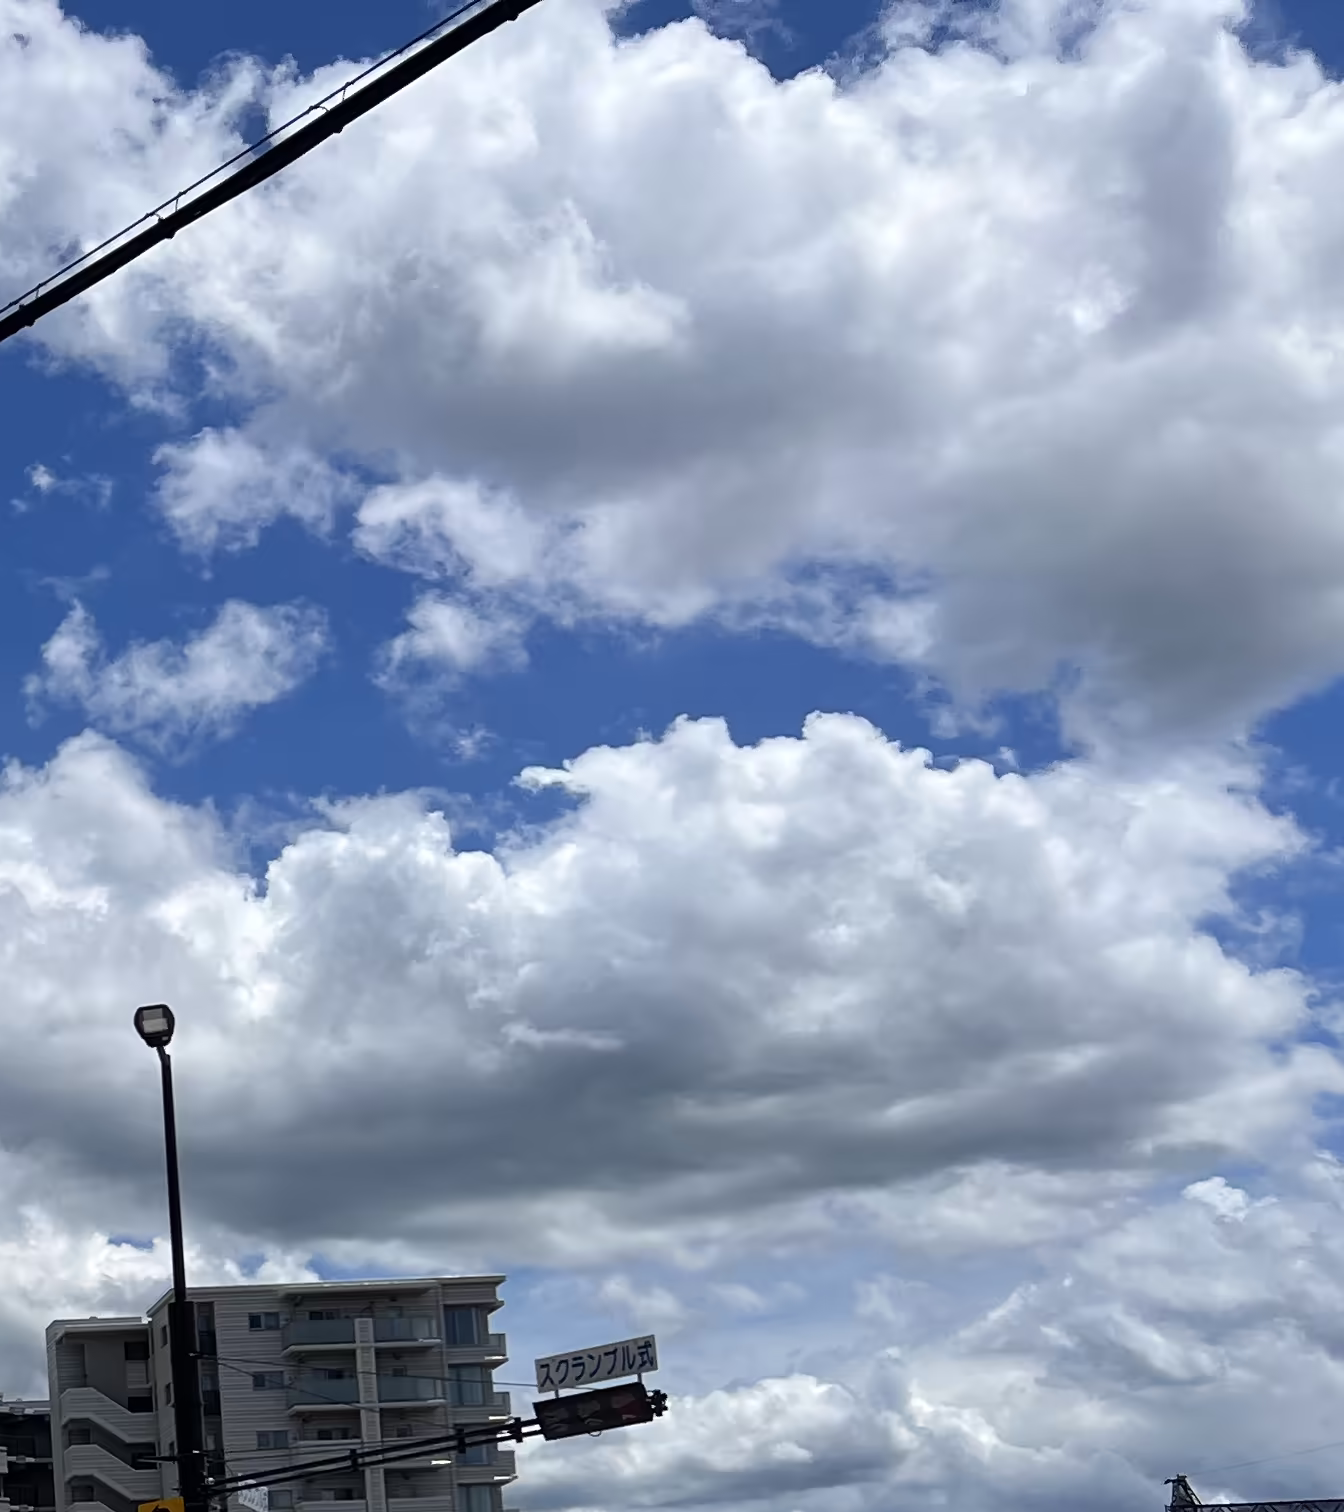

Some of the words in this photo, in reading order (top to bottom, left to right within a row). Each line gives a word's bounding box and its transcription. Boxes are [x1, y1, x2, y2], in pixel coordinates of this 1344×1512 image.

[540, 1341, 654, 1387] スクランブル式
